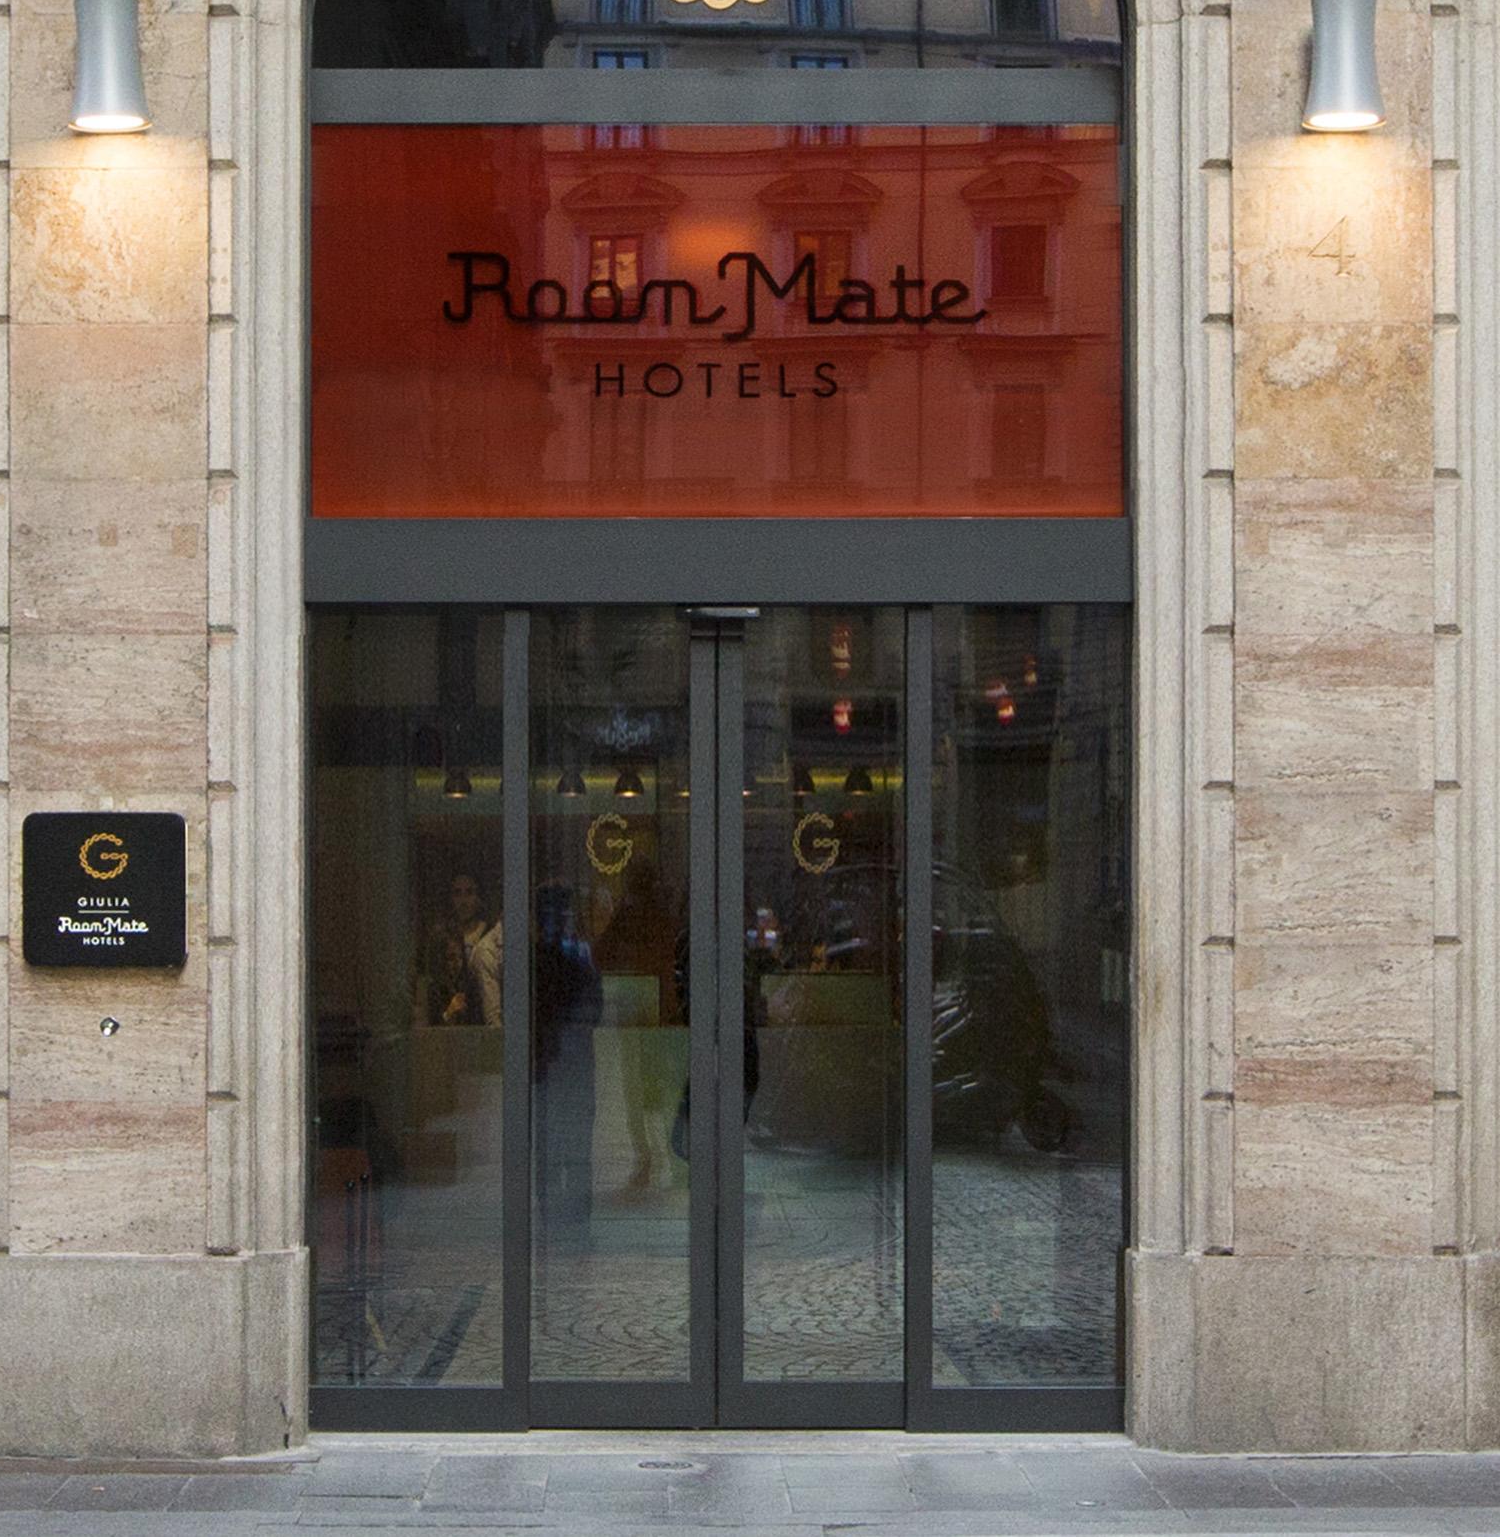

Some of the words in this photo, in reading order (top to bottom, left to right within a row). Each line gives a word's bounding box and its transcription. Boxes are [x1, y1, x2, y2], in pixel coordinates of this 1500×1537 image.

[593, 362, 841, 399] HOTELS
[77, 896, 131, 908] GIULIA
[82, 936, 126, 946] HOTELS
